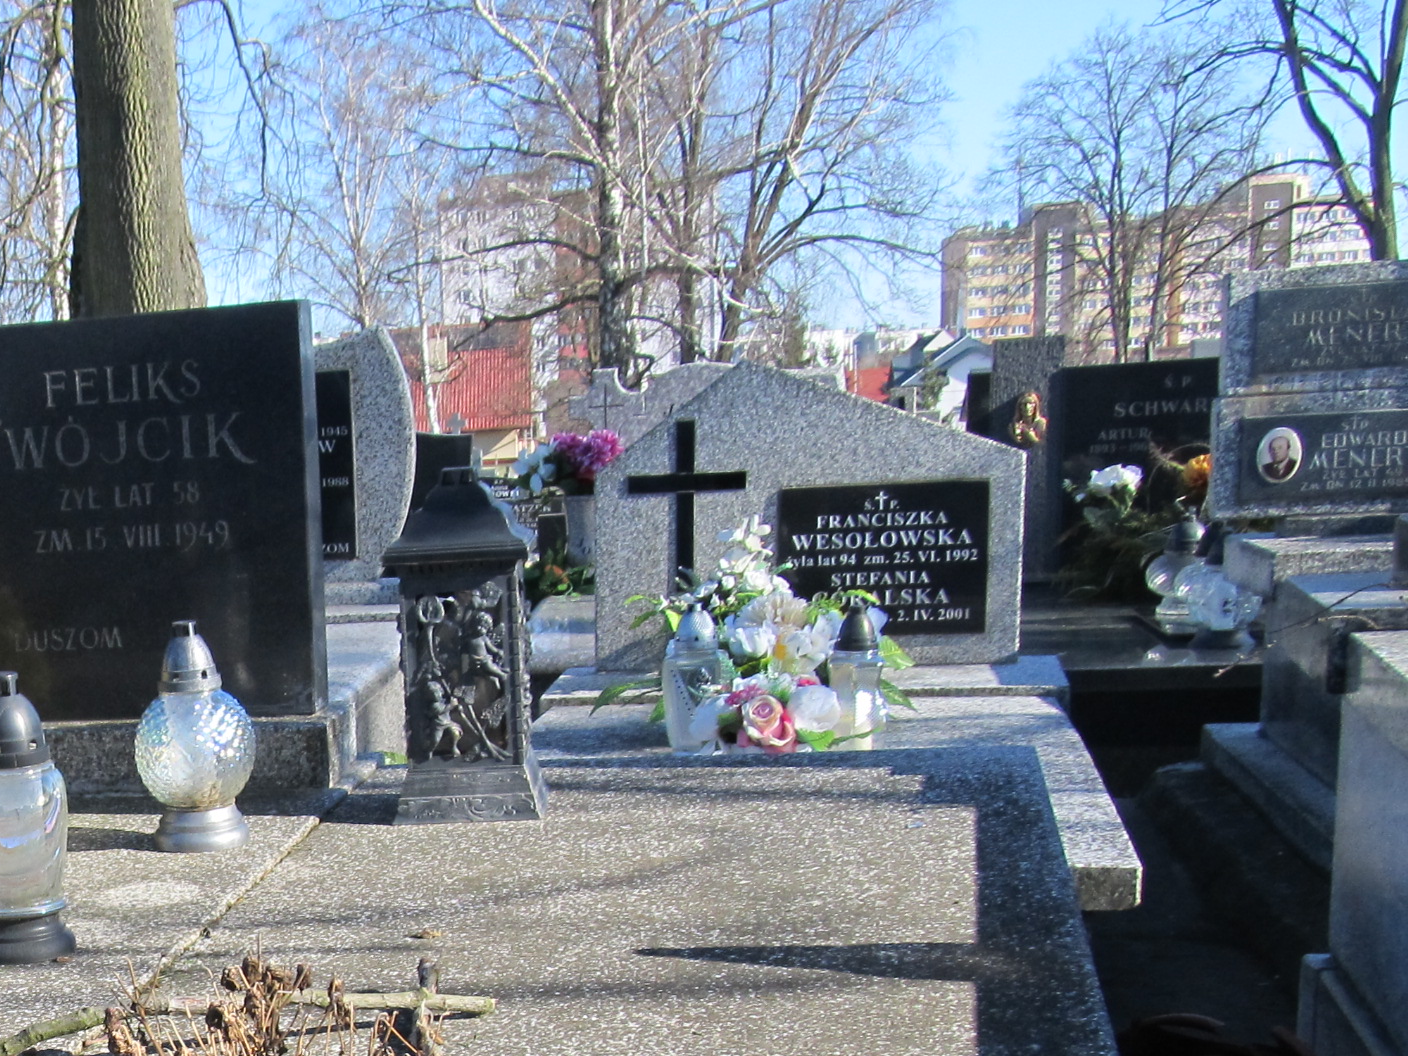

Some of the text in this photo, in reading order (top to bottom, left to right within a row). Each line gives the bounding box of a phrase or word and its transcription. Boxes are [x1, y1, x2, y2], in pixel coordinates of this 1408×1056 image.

[1303, 321, 1408, 347] MENER
[43, 358, 202, 409] FELIKS
[3, 410, 258, 471] WÓJCIK
[1321, 430, 1408, 448] EDWARD
[1309, 446, 1408, 470] MENER
[114, 481, 155, 508] LAT
[172, 480, 201, 505] 58
[816, 510, 950, 530] FRANCISZKA
[175, 519, 232, 553] 1949
[791, 528, 974, 551] WESOŁOWSKA
[817, 554, 836, 566] lat
[839, 552, 857, 566] 94
[863, 554, 891, 566] zm.
[893, 550, 915, 564] 25.
[945, 547, 979, 562] 1992
[830, 569, 932, 587] STEFANIA
[937, 607, 971, 621] 2001
[14, 625, 124, 653] DUSZOM
